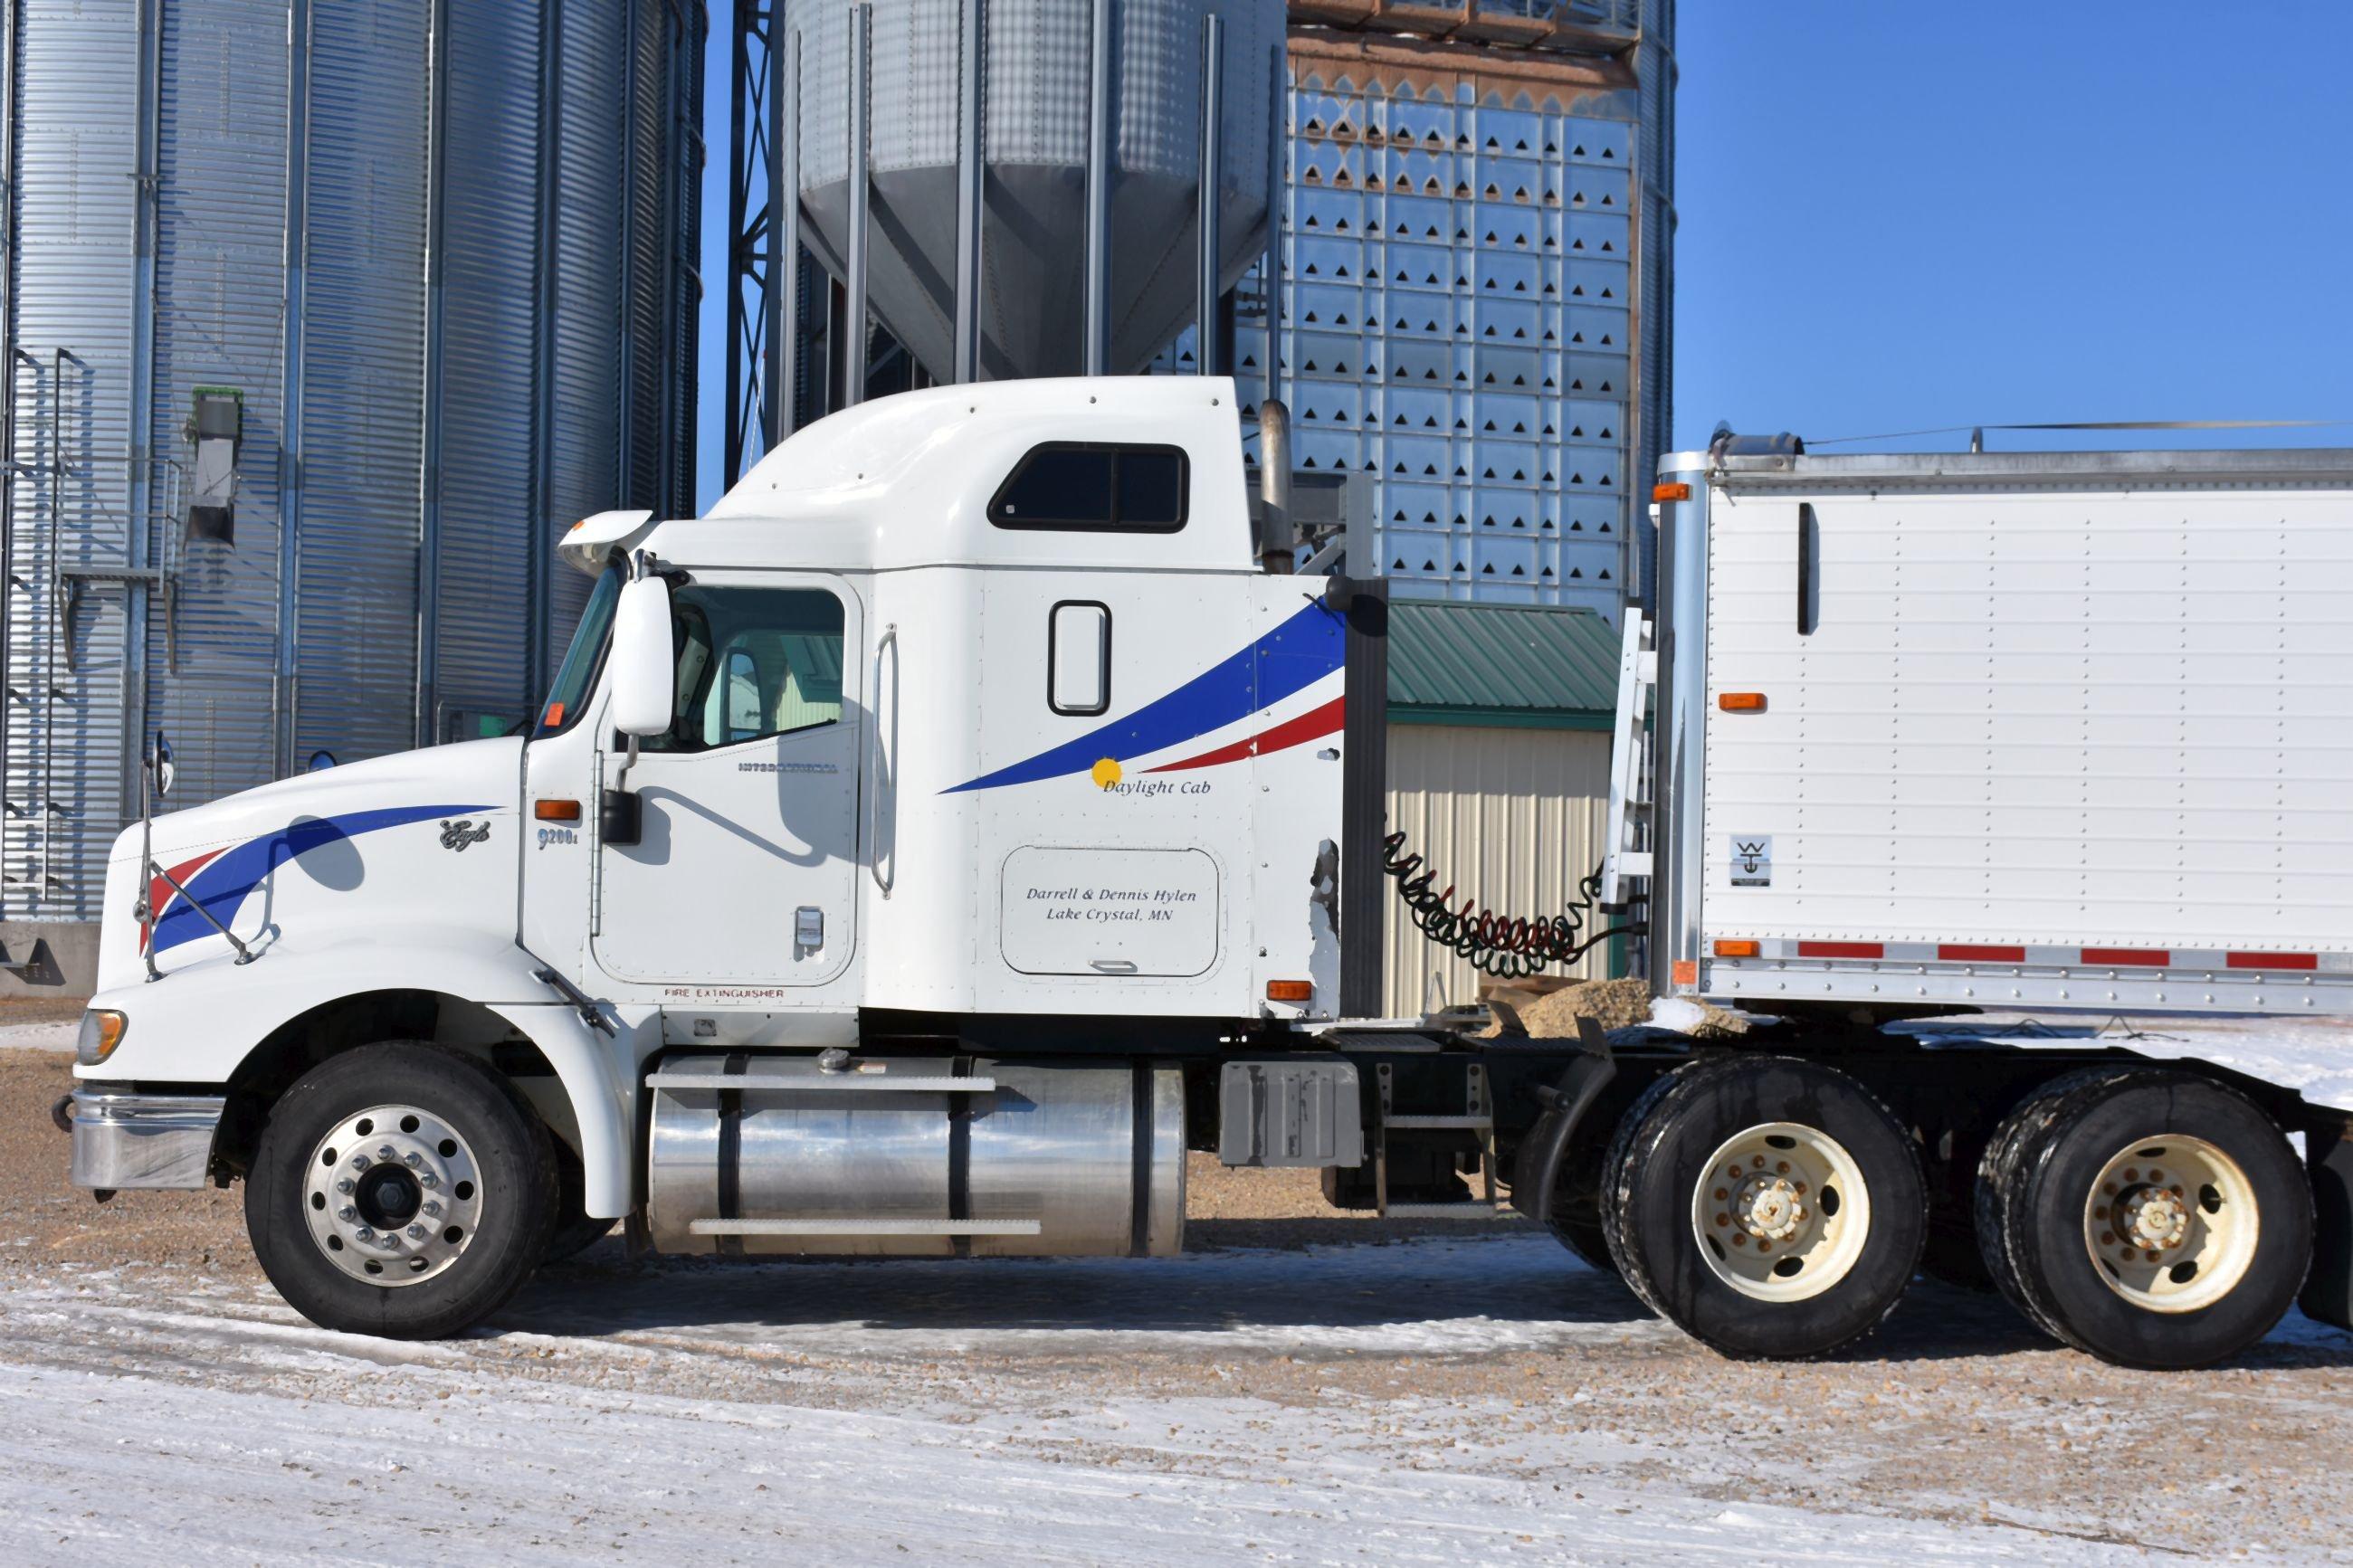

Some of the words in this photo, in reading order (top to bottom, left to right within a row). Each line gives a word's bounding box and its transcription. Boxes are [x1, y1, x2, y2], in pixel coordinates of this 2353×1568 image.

[1103, 779, 1175, 797] Daylight
[1180, 780, 1211, 794] Cab
[1026, 888, 1078, 900] Darrell
[1081, 889, 1093, 900] &
[1099, 889, 1149, 901] Dennis
[1154, 889, 1196, 905] Hylen
[1046, 908, 1081, 920] Lake
[1086, 908, 1143, 923] Crystal,
[1148, 909, 1174, 921] MN
[664, 988, 690, 998] FIRE
[696, 988, 784, 999] EXTINGUISHER
